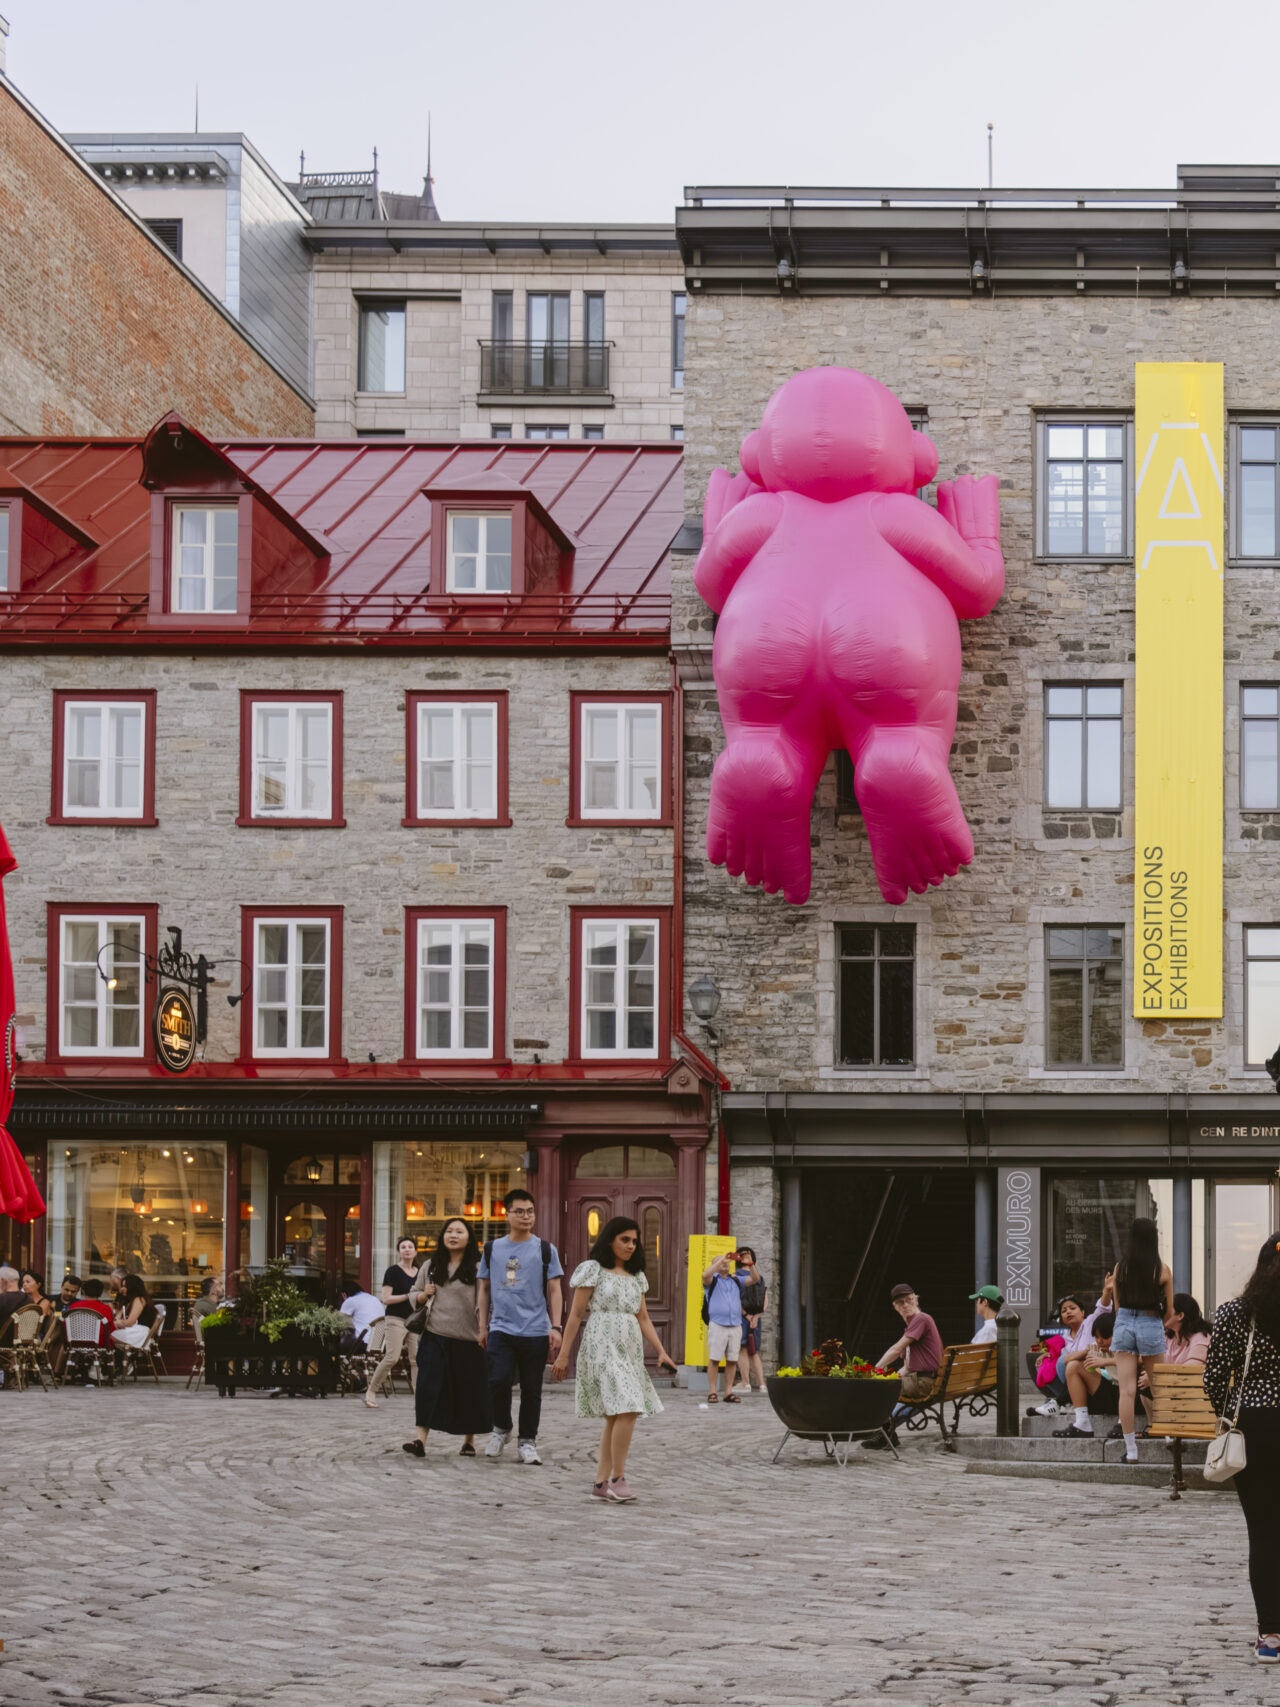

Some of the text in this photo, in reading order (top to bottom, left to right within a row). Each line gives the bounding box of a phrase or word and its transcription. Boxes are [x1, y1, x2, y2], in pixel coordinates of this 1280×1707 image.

[1143, 846, 1163, 1009] EXPOSITIONS
[1169, 871, 1188, 1009] EXHIBITIONS
[161, 1013, 191, 1036] SMITH
[1006, 1171, 1031, 1306] EXMURO
